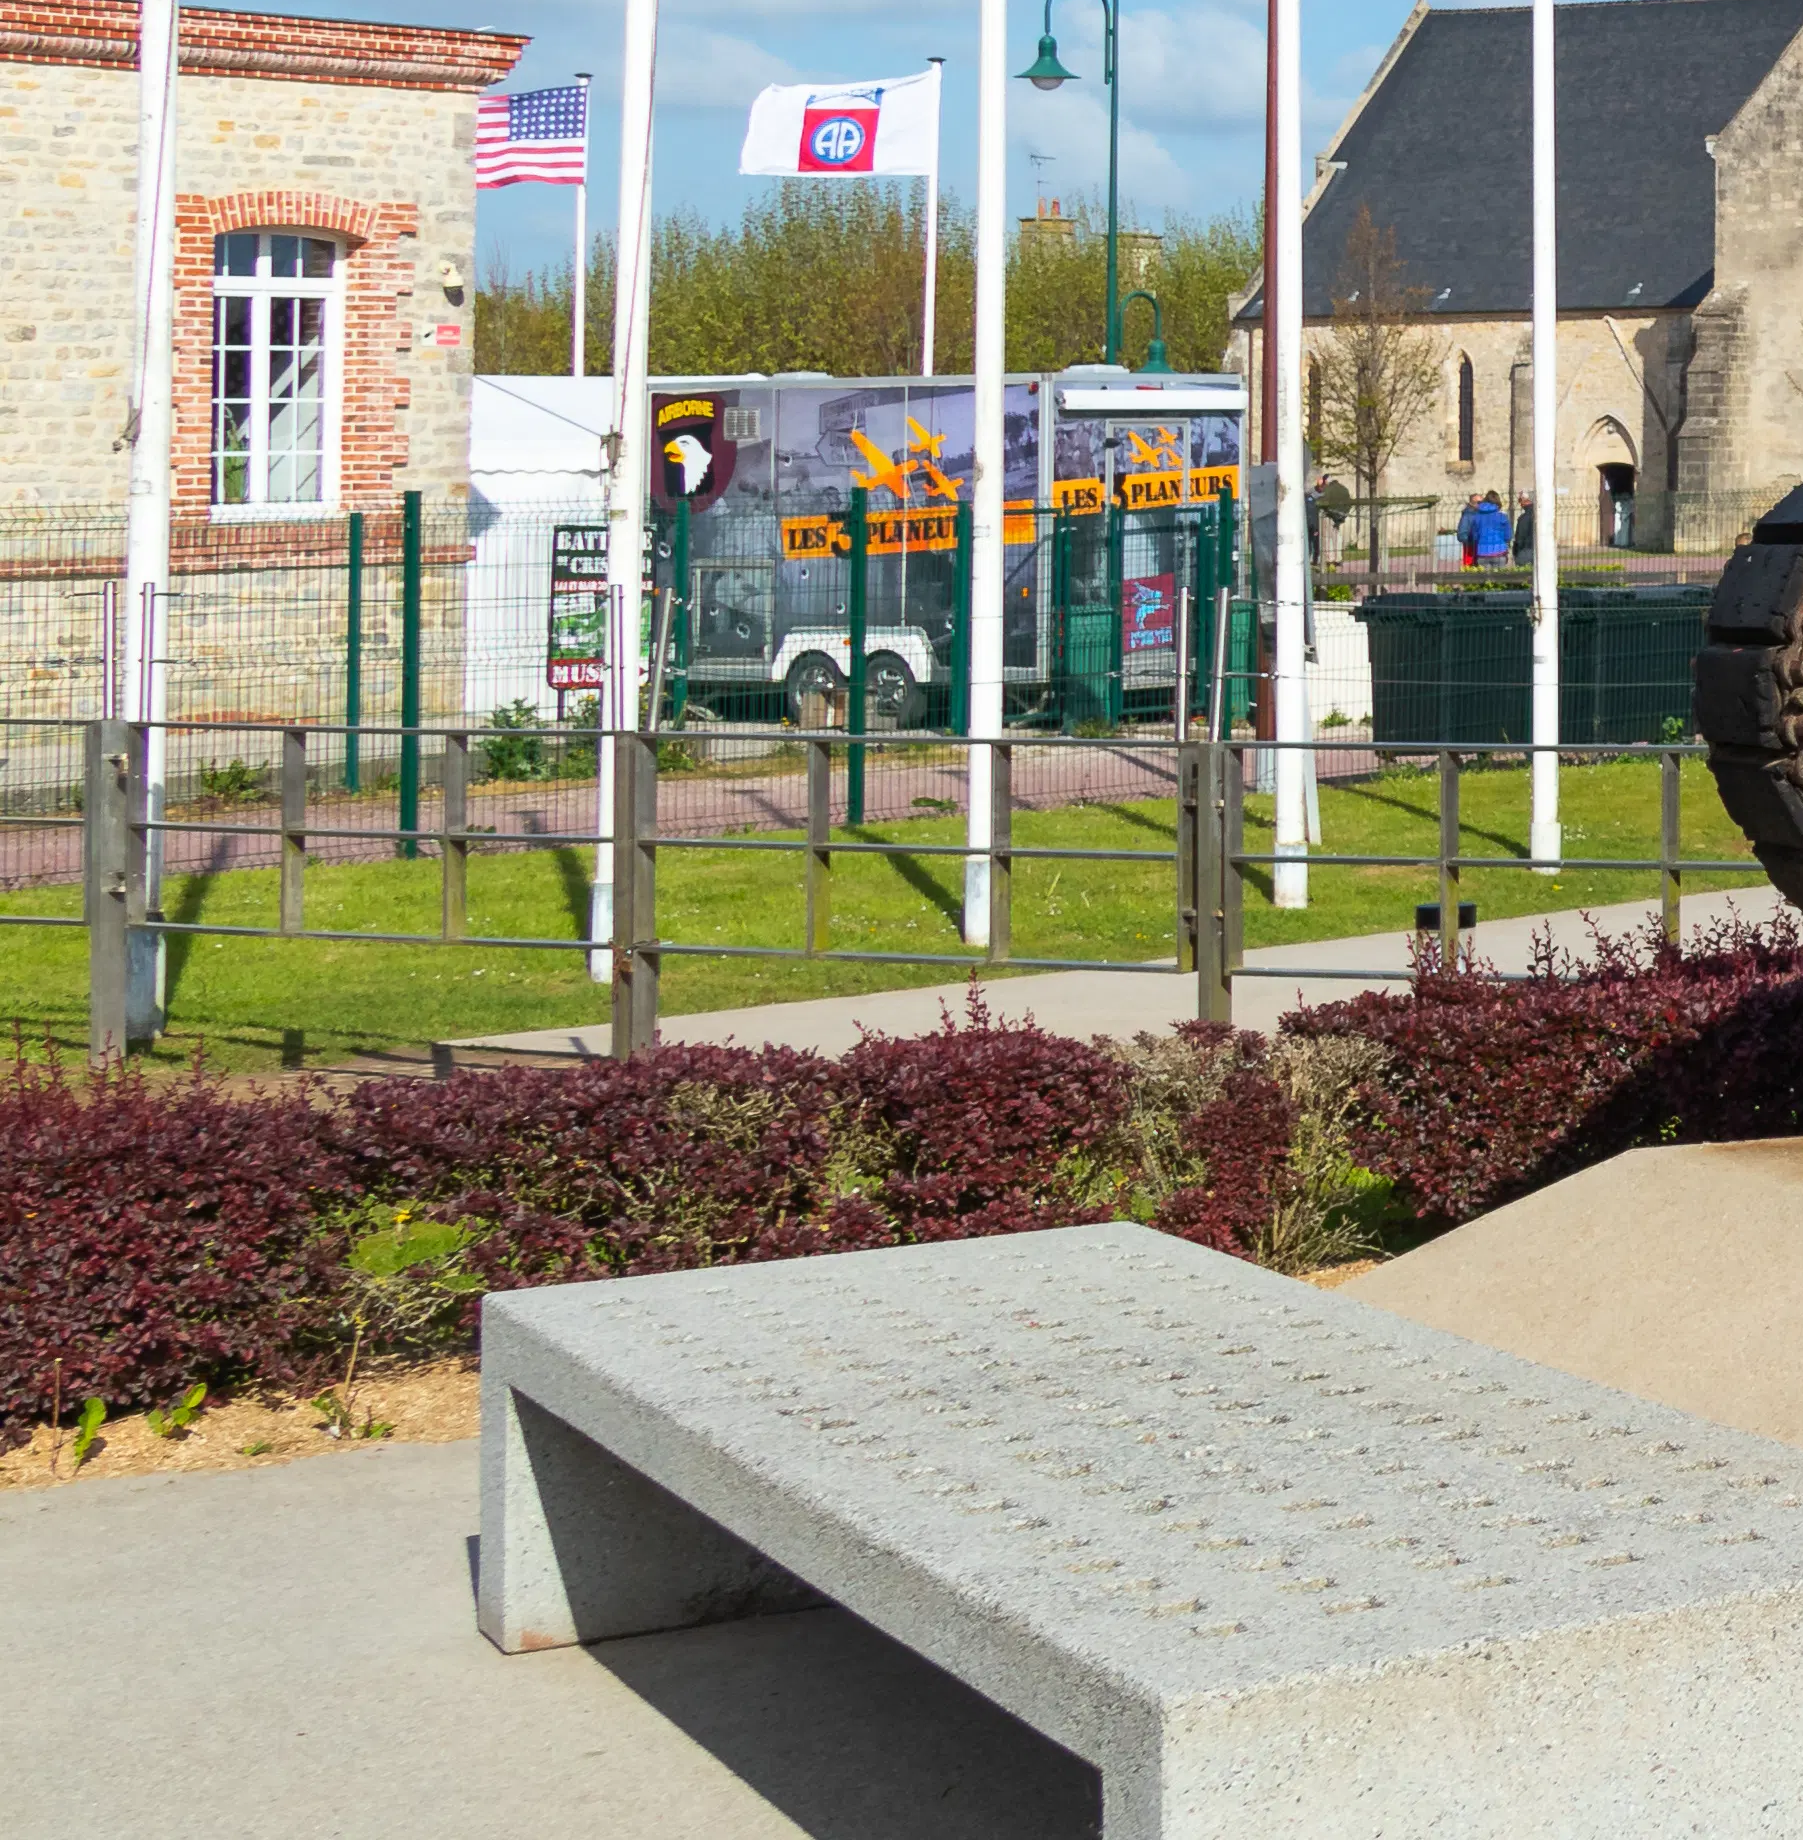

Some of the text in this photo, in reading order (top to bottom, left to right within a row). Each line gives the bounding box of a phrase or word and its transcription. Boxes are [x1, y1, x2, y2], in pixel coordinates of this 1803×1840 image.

[814, 121, 861, 159] AA
[657, 399, 715, 428] AIRBORNE
[1061, 486, 1099, 511] LES
[1130, 473, 1234, 504] PLANEURS
[787, 525, 828, 551] LES
